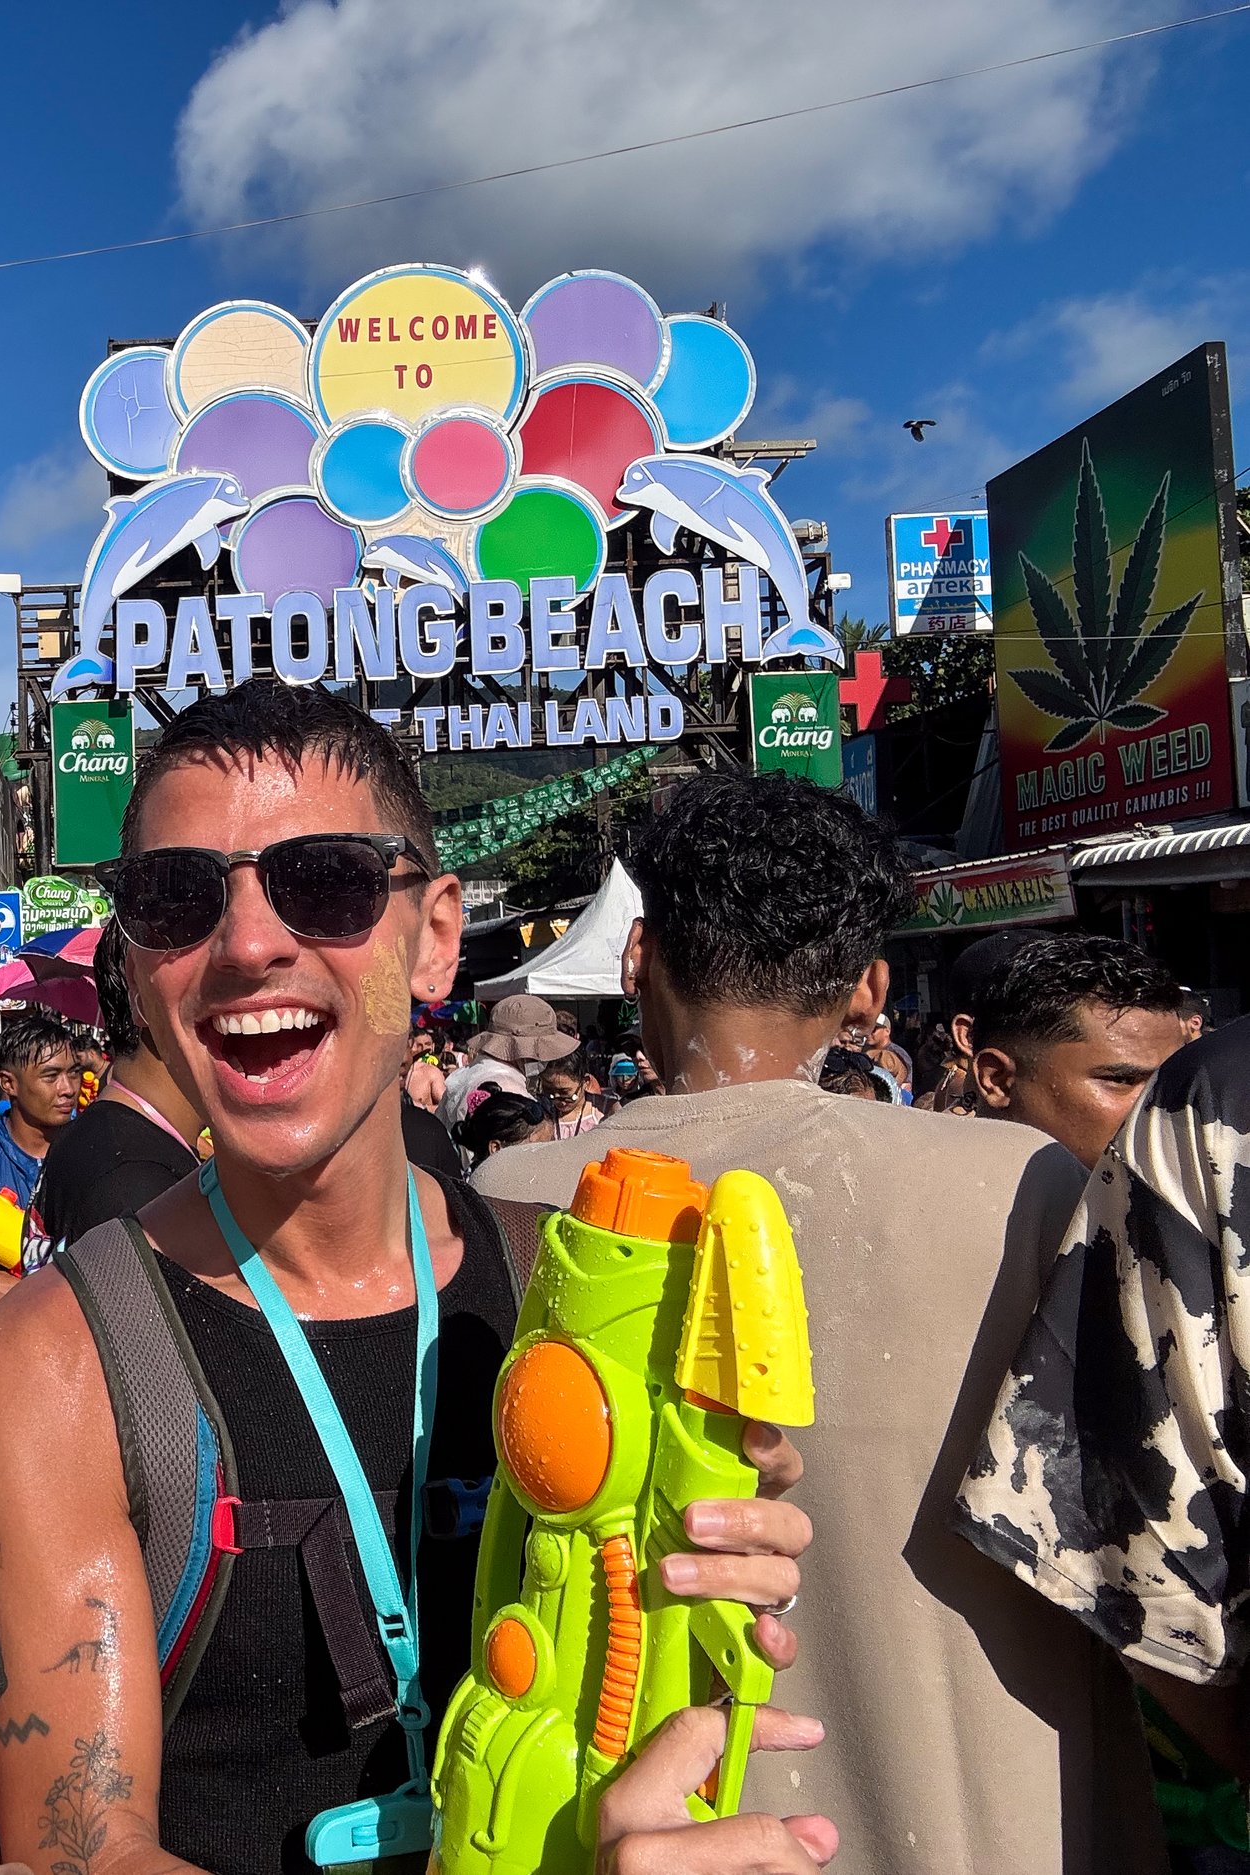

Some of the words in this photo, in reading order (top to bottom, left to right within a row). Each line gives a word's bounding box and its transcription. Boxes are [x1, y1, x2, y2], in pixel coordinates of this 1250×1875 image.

[337, 314, 497, 342] WELCOME
[394, 364, 433, 389] TO
[900, 559, 989, 578] PHARMACY
[907, 579, 984, 596] аптека
[116, 586, 455, 692] PATONG
[468, 565, 762, 676] BEACH
[927, 614, 967, 631] 药店
[758, 725, 834, 750] Chang
[58, 752, 129, 775] Chang
[1016, 751, 1106, 812] MAGIC
[1117, 723, 1212, 786] WEED
[1018, 817, 1037, 838] THE
[1041, 813, 1068, 833] BEST
[1072, 801, 1119, 826] QUALITY
[1125, 785, 1189, 815] CANNABIS
[1195, 780, 1212, 798] !!!
[35, 885, 72, 902] Chang
[962, 873, 1056, 913] CANNABIS
